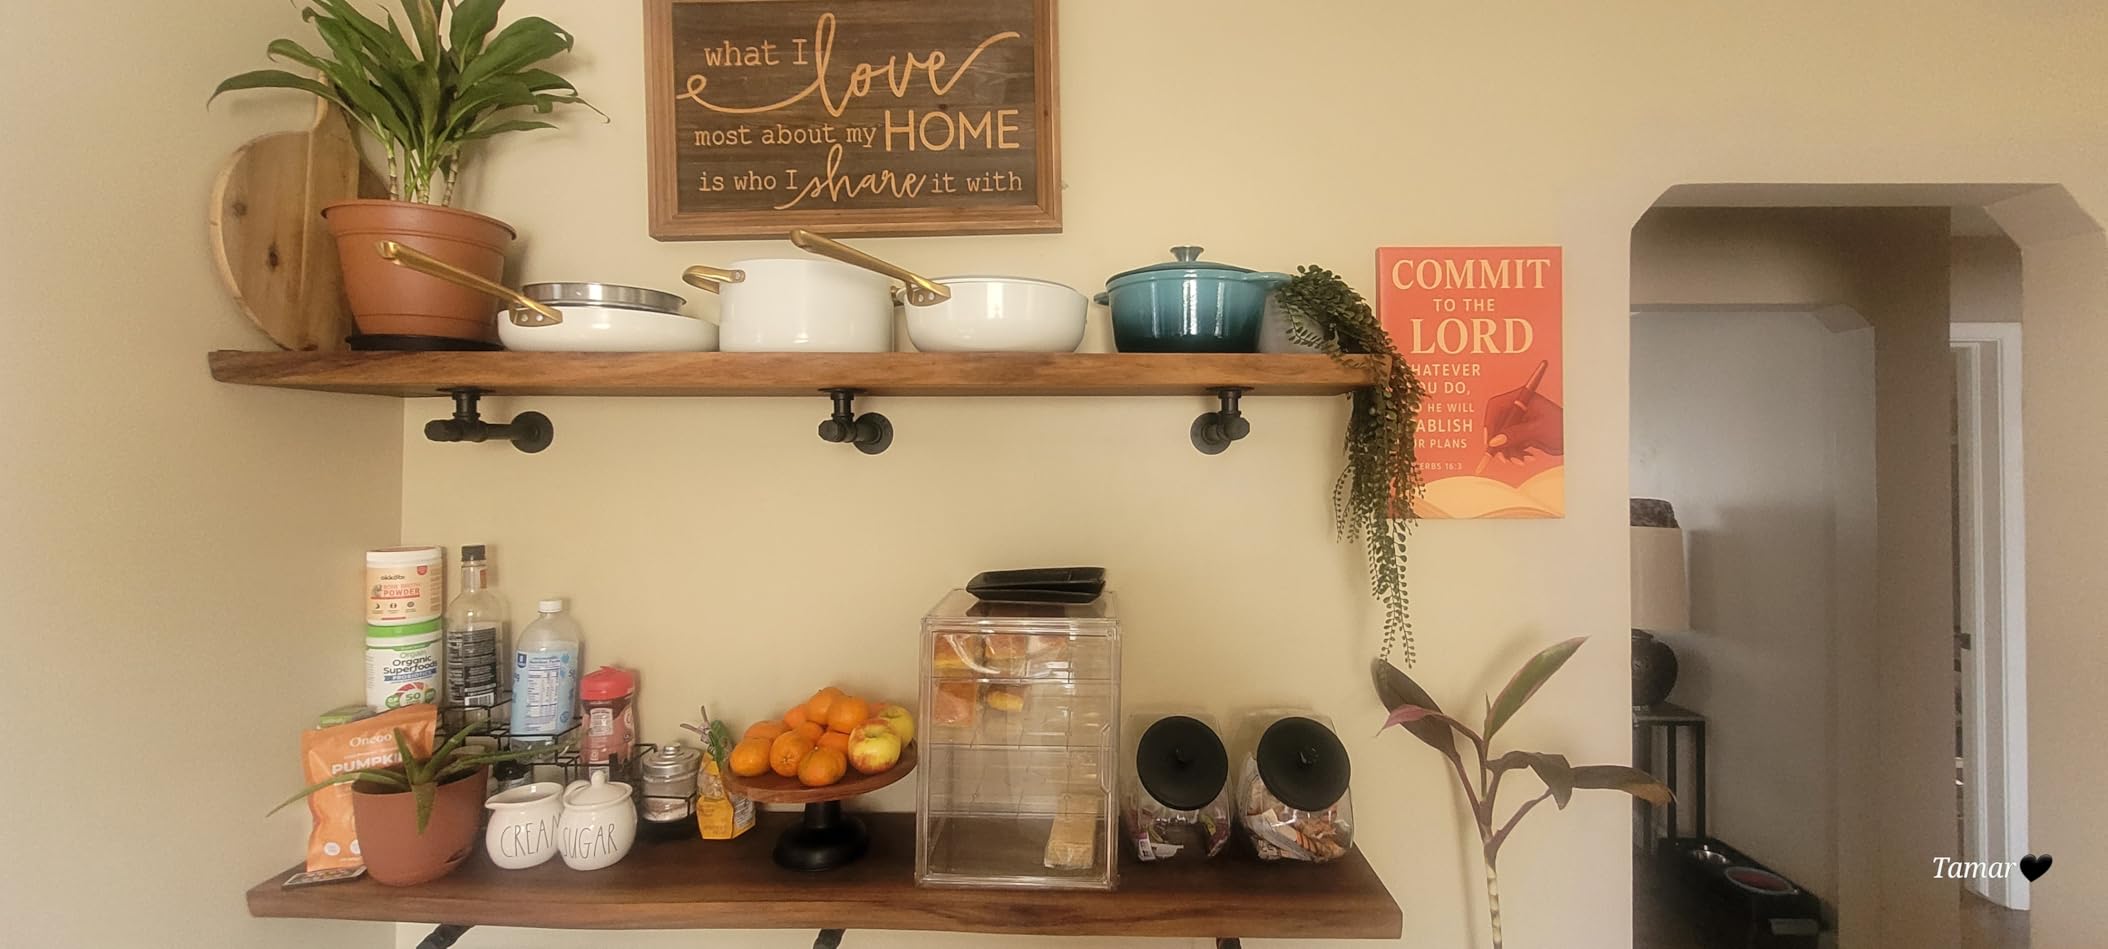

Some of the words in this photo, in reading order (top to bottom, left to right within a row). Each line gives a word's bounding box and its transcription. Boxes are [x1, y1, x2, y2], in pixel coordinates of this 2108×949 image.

[703, 39, 780, 67] what
[792, 38, 808, 65] I
[693, 125, 752, 147] most
[760, 123, 837, 145] about
[845, 126, 877, 149] my
[884, 109, 1020, 151] HOME
[698, 171, 725, 192] is
[733, 170, 777, 191] who
[774, 143, 928, 210] share
[785, 169, 799, 191] I
[931, 171, 956, 194] it
[966, 170, 1024, 192] with
[1391, 258, 1551, 290] COMMIT
[1433, 298, 1456, 312] TO
[1462, 298, 1495, 312] THE
[1409, 318, 1534, 354] LORD
[1410, 363, 1481, 377] HATEVER
[1444, 381, 1471, 396] DO,
[1427, 403, 1443, 413] HE
[1447, 403, 1475, 413] WILL
[1416, 418, 1473, 433] ABLISH
[1429, 438, 1468, 449] PLANS
[383, 588, 420, 597] POWDER
[383, 661, 437, 676] Superfoods
[392, 655, 432, 668] Organic
[405, 692, 421, 701] 50
[562, 823, 618, 859] SUGAR
